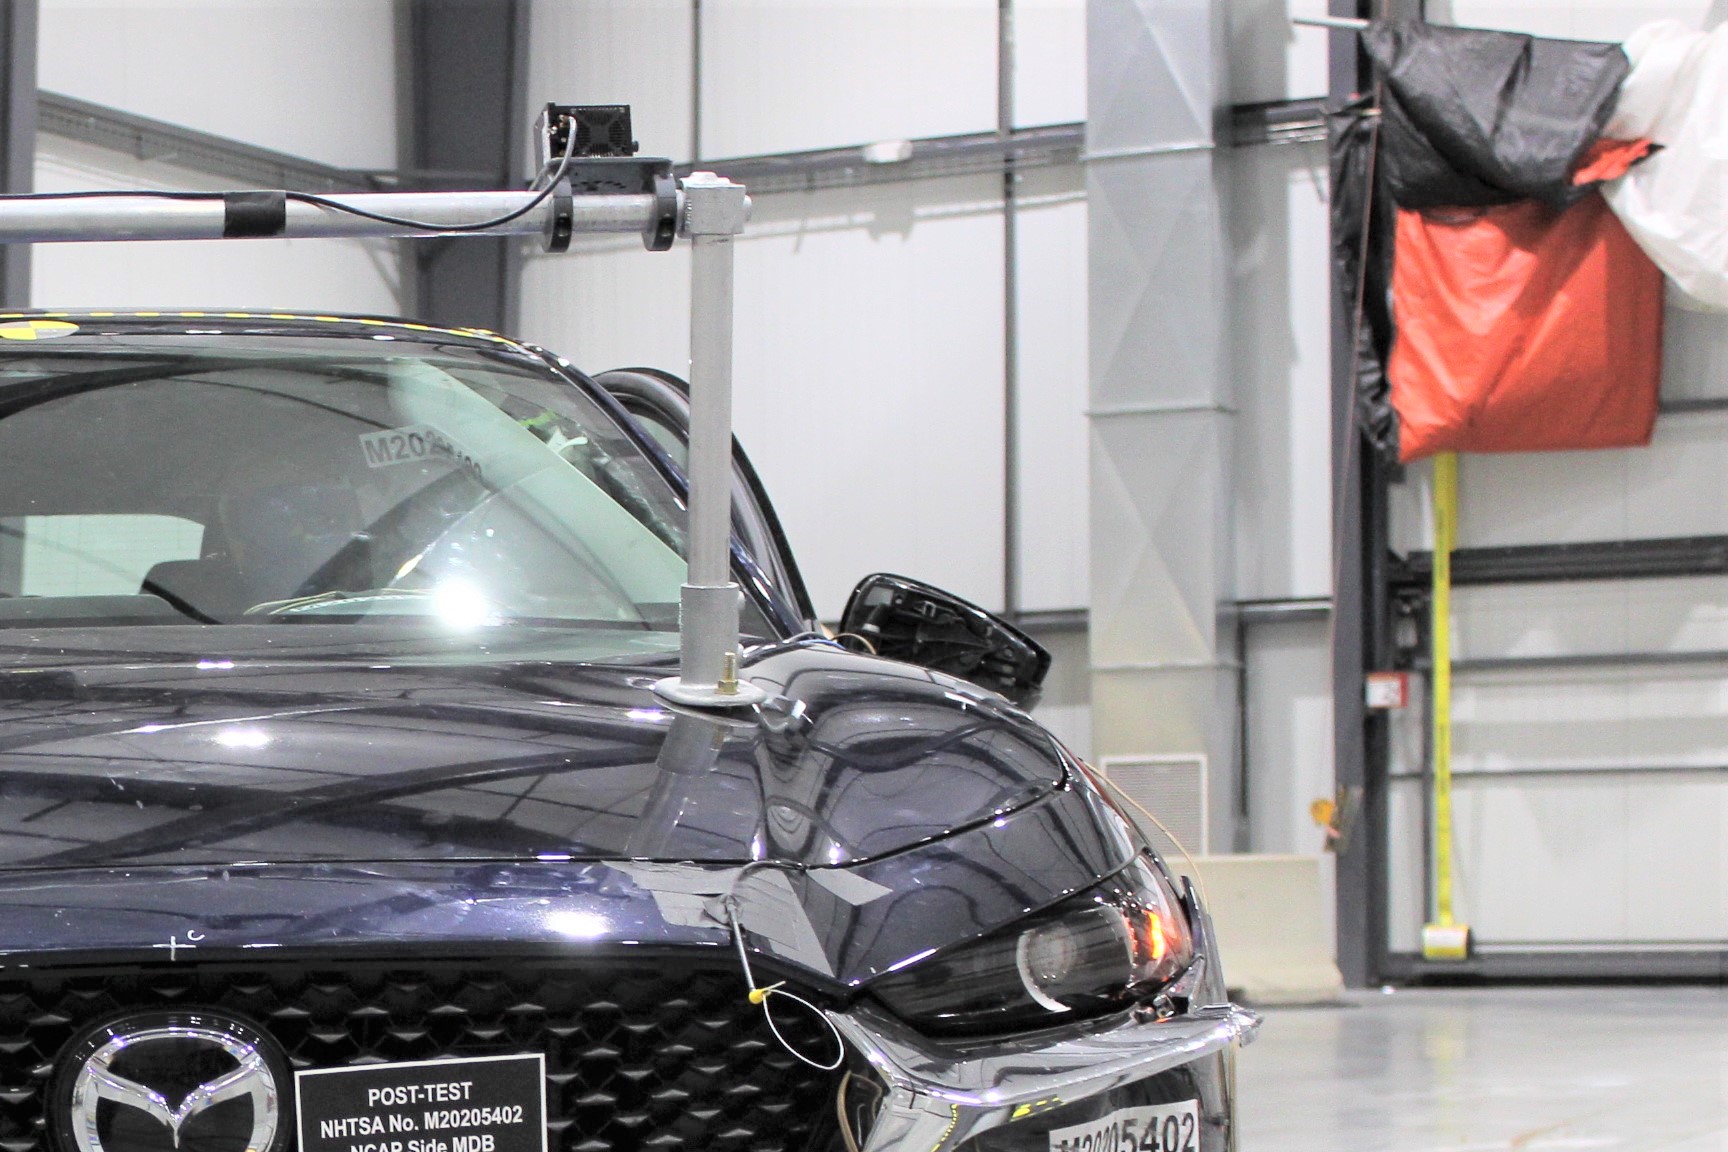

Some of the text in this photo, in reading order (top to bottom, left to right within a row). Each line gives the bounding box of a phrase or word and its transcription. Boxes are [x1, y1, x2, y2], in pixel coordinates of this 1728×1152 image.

[368, 1081, 473, 1106] POST-TEST
[321, 1105, 523, 1138] NHTSA No. M20205402
